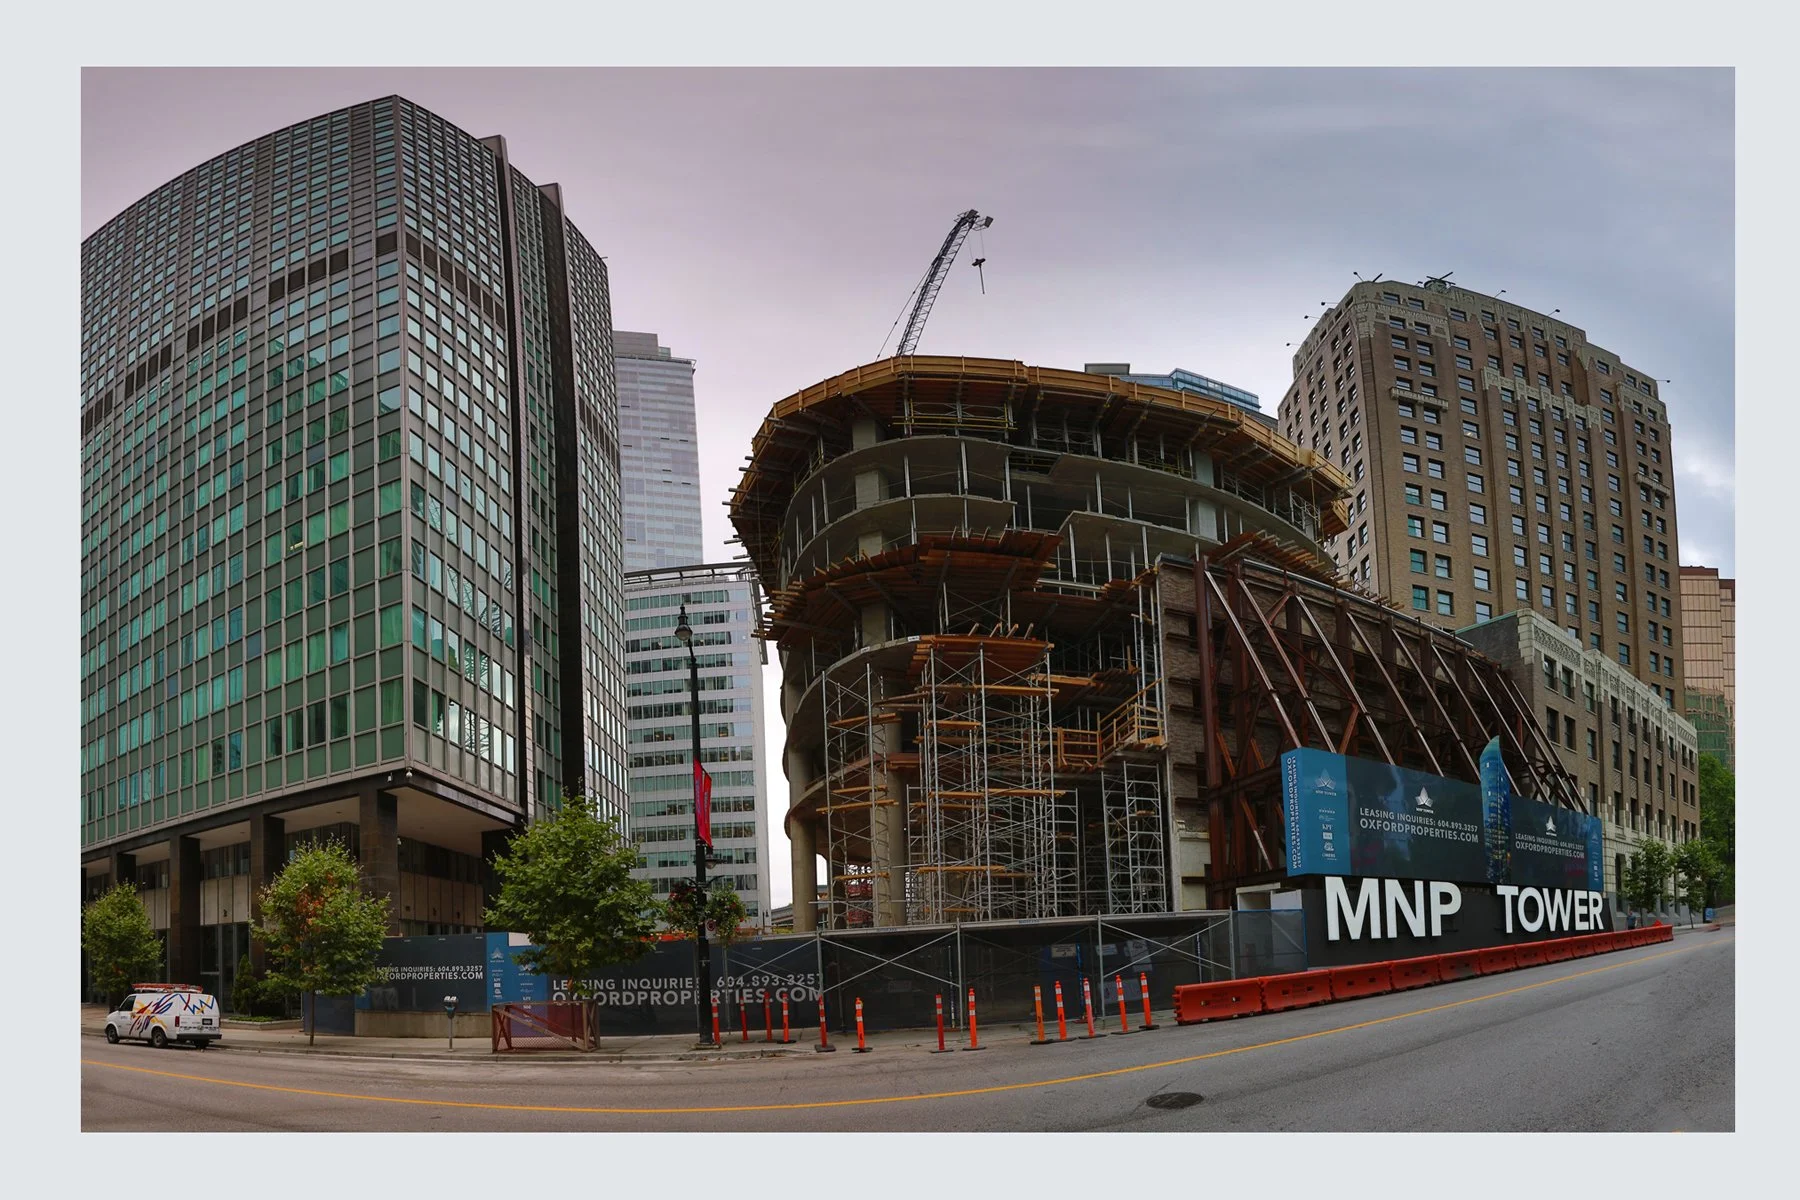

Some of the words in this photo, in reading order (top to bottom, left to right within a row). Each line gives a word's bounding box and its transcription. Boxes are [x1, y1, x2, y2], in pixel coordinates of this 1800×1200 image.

[1286, 757, 1298, 869] OXFORDPROPERTIES.COM
[1360, 807, 1395, 820] LEASING
[1397, 813, 1436, 827] INQUIRIES:
[1437, 820, 1478, 833] 604.893.3257
[1360, 818, 1479, 843] OXFORDPROPERTIES.COM
[1515, 832, 1536, 842] LEASING
[1515, 841, 1585, 859] OXFORDPROPERTIES.COM
[1324, 876, 1462, 941] MNP
[1497, 885, 1605, 934] TOWER
[375, 971, 484, 980] XFORDPROPERTIES.COM
[437, 965, 483, 973] 604.893.3257
[553, 978, 616, 990] LESING
[716, 973, 823, 988] 604.893.325
